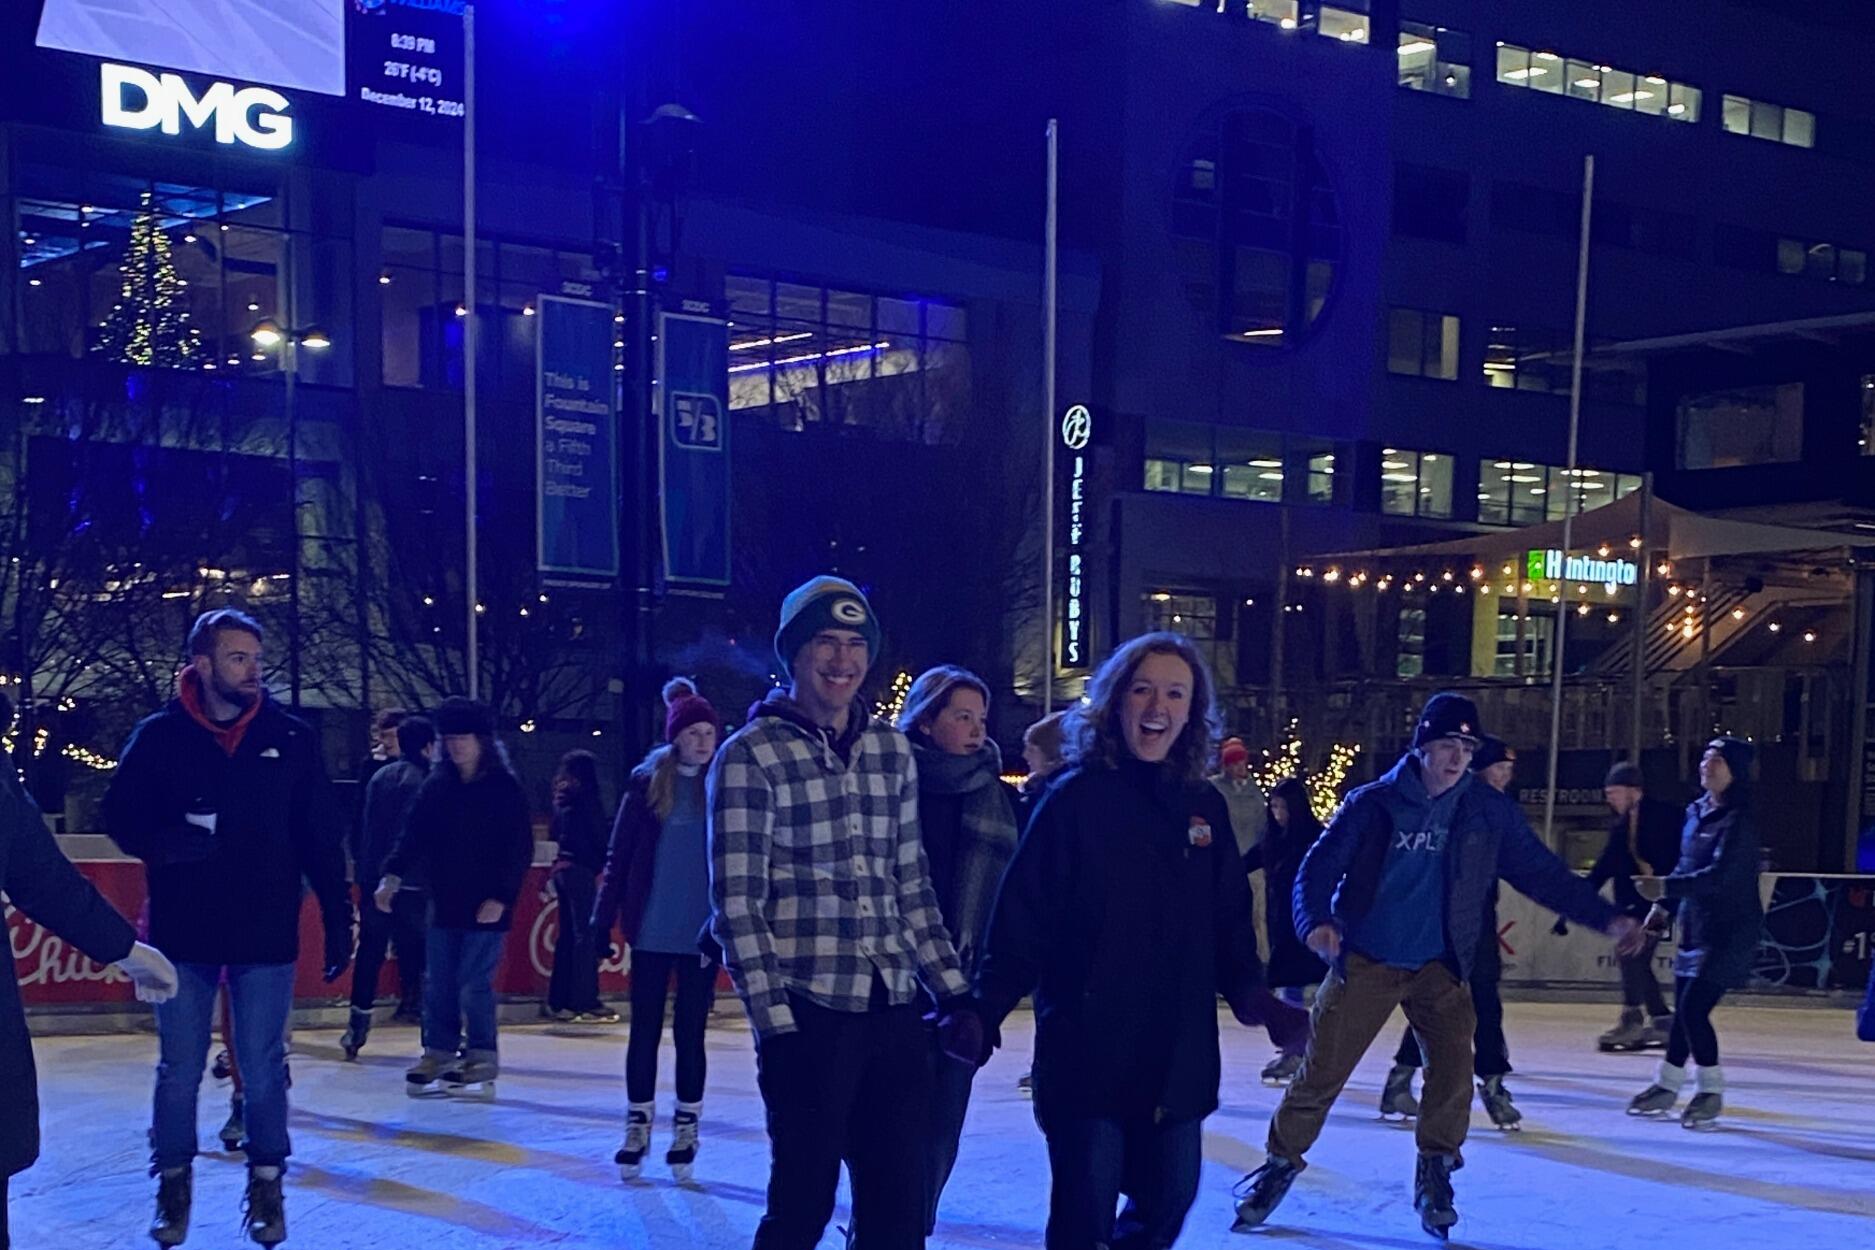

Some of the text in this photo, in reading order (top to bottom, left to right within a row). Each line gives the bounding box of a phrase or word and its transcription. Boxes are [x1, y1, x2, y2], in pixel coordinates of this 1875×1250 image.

[416, 37, 435, 54] PM
[101, 62, 293, 149] DMG
[361, 87, 465, 117] December 12, 2024
[1546, 549, 1638, 594] Hntingto
